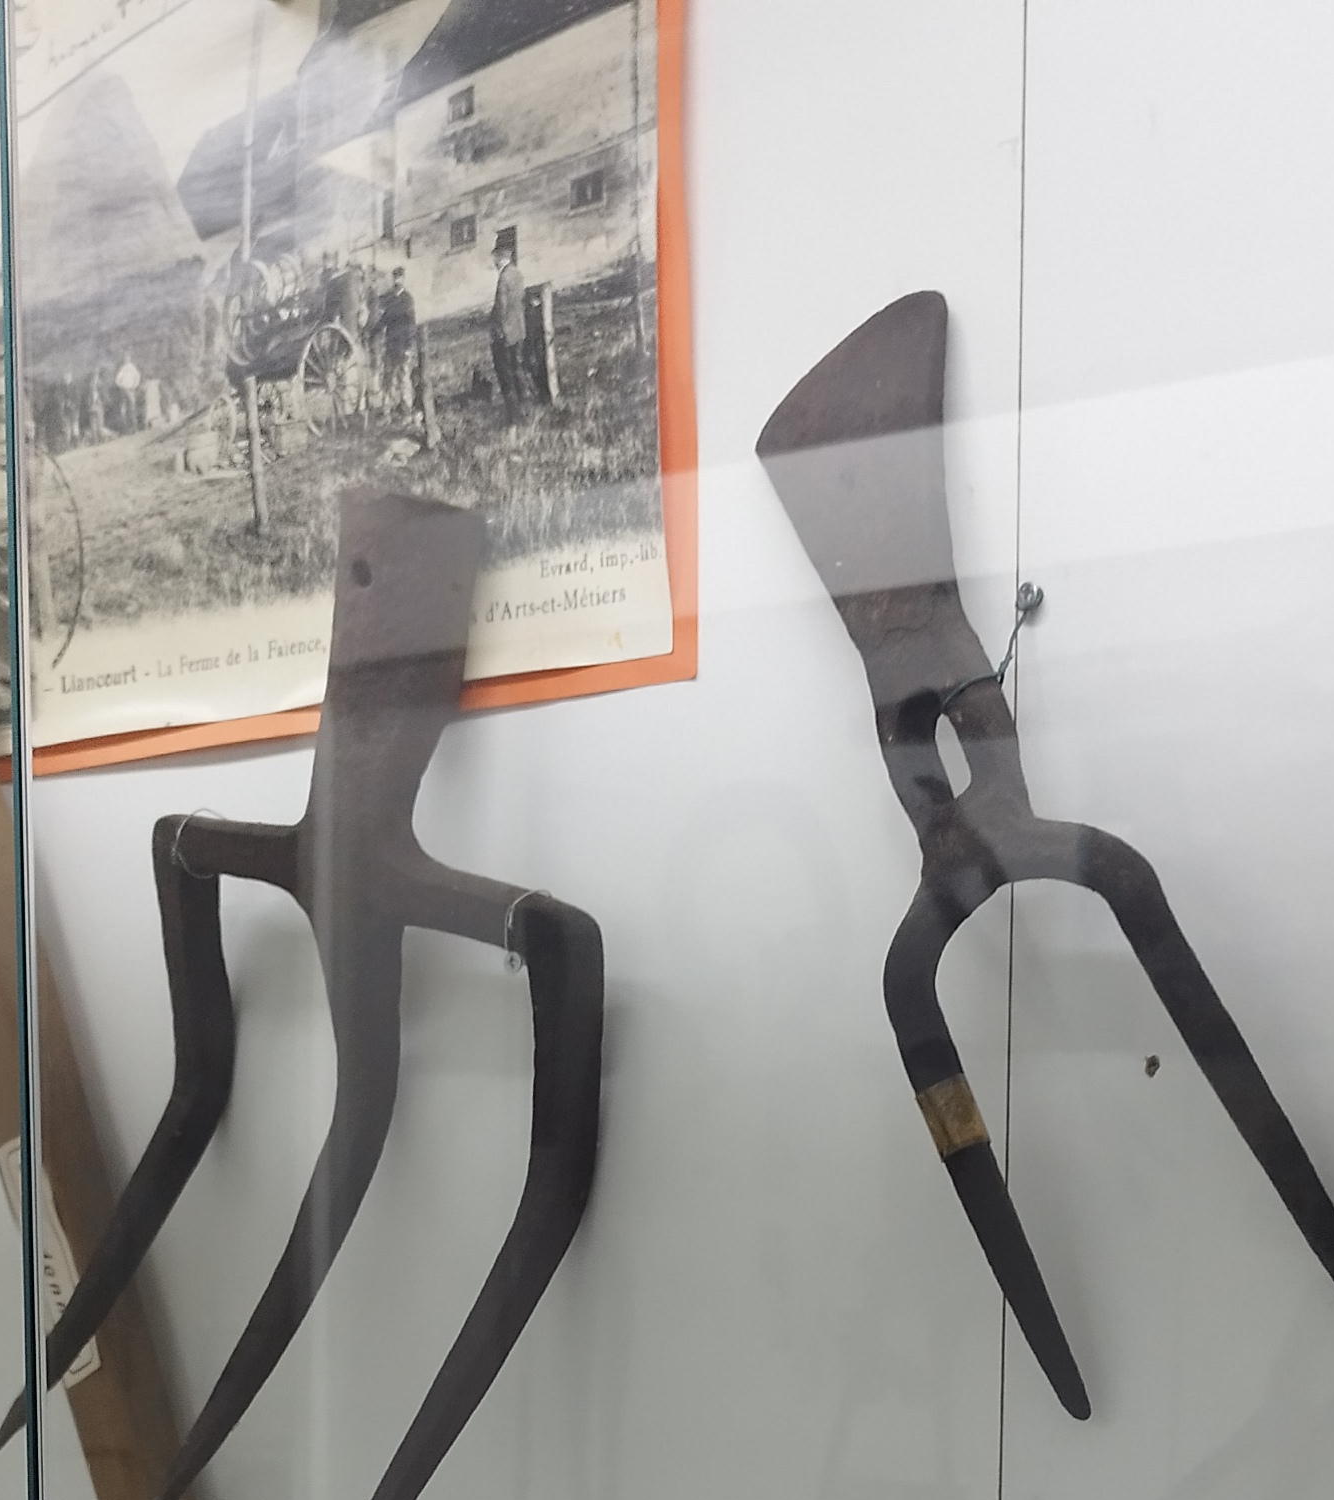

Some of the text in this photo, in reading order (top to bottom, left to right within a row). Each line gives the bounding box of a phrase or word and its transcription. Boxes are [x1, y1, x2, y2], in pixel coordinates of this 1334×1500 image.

[540, 552, 594, 579] Evrard,
[61, 664, 137, 694] Liancourt
[157, 659, 172, 678] La
[179, 654, 220, 675] Ferme
[226, 648, 241, 666] de
[248, 643, 259, 662] la
[485, 586, 626, 624] d'Arts-et-Métiers
